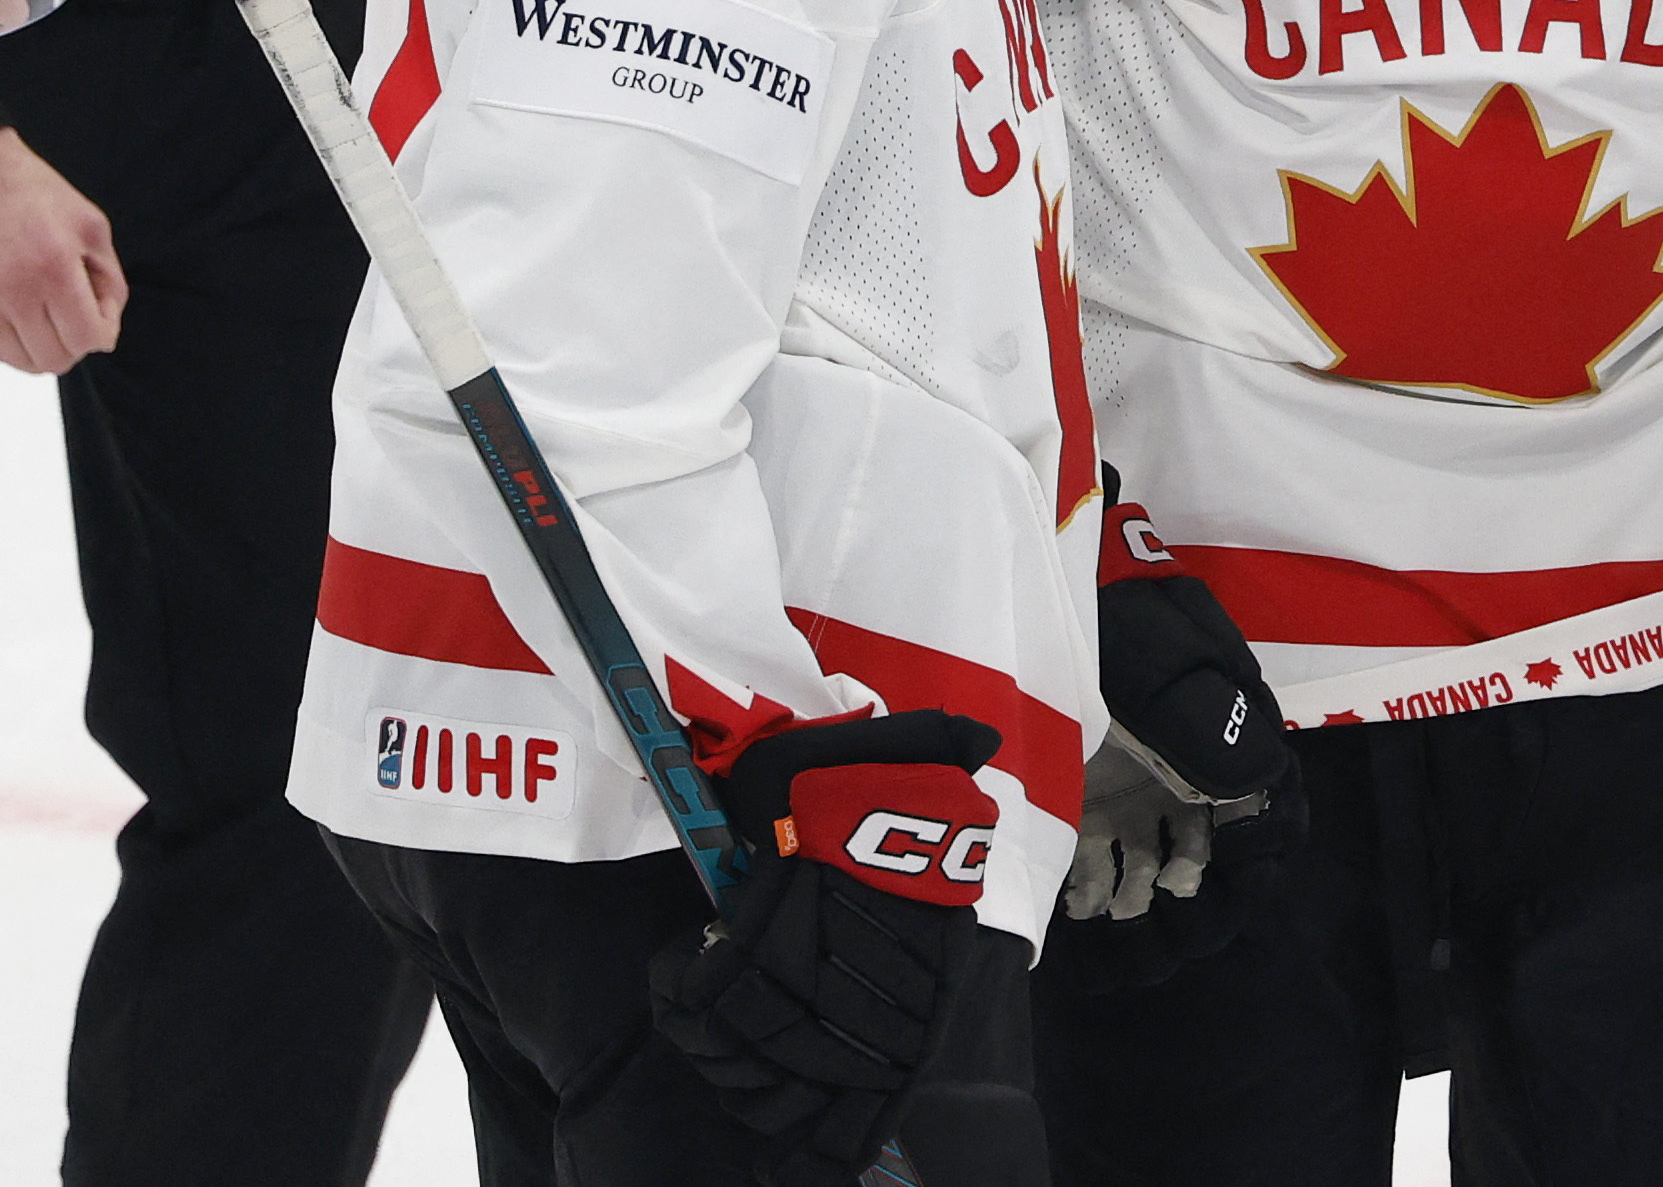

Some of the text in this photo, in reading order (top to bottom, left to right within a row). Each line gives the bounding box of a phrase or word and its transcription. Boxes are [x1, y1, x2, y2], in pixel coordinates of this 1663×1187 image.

[611, 66, 704, 105] GROUP
[411, 724, 559, 804] IIHF
[842, 809, 995, 883] CC
